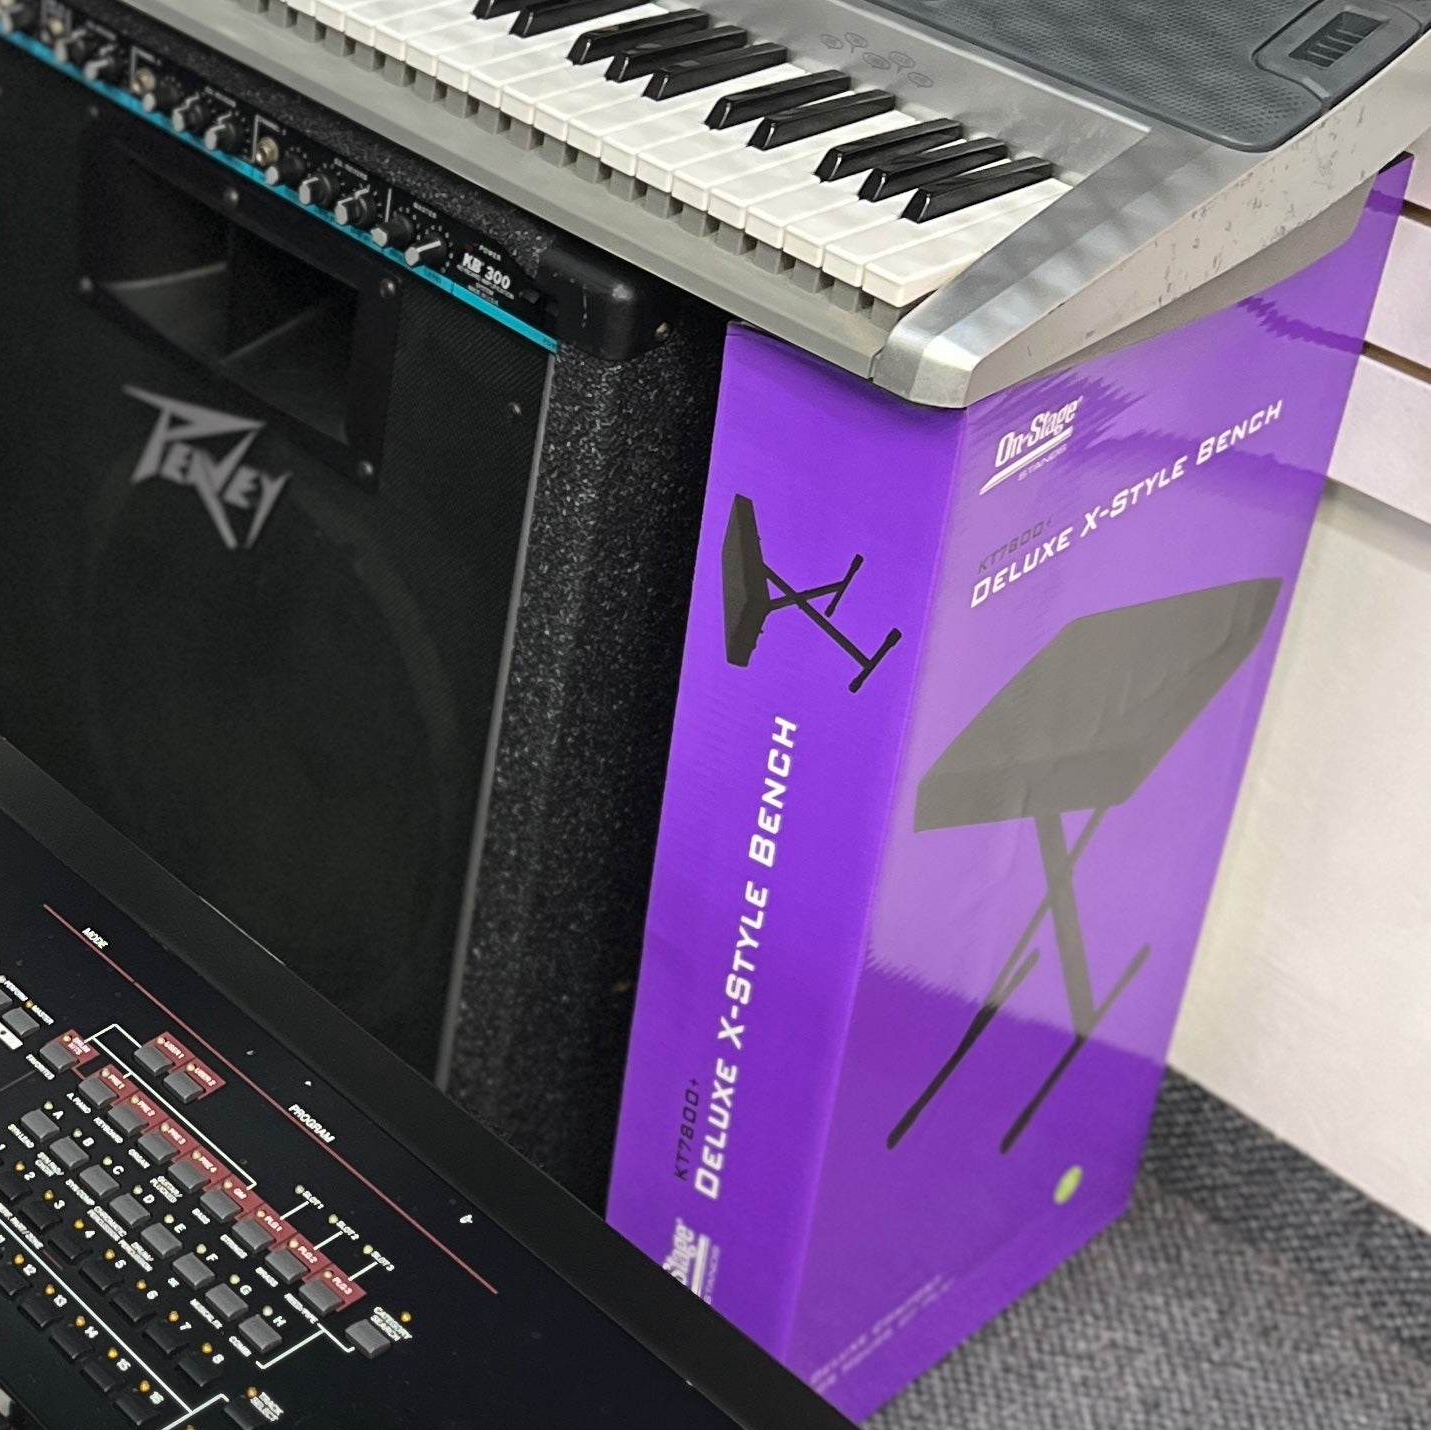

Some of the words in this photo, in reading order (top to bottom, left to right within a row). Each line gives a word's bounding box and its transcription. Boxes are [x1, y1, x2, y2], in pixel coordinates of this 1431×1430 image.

[463, 252, 482, 274] KB
[484, 265, 511, 290] 300
[994, 399, 1080, 469] On-Stage
[122, 384, 292, 550] PEAVEY
[1018, 443, 1069, 481] STANDS
[970, 525, 1074, 609] DELUXE
[1080, 454, 1189, 538] X-STYLE
[1195, 399, 1284, 467] BENCH
[81, 927, 109, 950] MODE
[693, 1057, 739, 1200] DELUXE
[717, 879, 770, 1051] X-STYLE
[747, 715, 799, 869] BENCH
[4, 979, 29, 1002] PERFORM
[31, 1004, 55, 1026] MASTER
[52, 1110, 64, 1120] A
[287, 1103, 336, 1144] PROGRAM
[674, 1077, 700, 1182] KT7800+
[82, 1136, 95, 1148] B
[23, 1171, 36, 1181] 2
[112, 1165, 125, 1176] C
[53, 1199, 66, 1210] 3
[142, 1193, 155, 1204] D
[84, 1230, 96, 1239] 4
[173, 1222, 187, 1235] E
[205, 1252, 219, 1263] F
[661, 1216, 696, 1287] Stage
[23, 1263, 37, 1277] 12
[114, 1259, 127, 1269] 5
[146, 1290, 159, 1300] 6
[239, 1284, 253, 1296] G
[53, 1294, 68, 1308] 13
[179, 1321, 192, 1331] 7
[272, 1314, 287, 1328] H
[84, 1325, 99, 1339] 14
[116, 1358, 132, 1372] 15
[212, 1353, 225, 1365] 8
